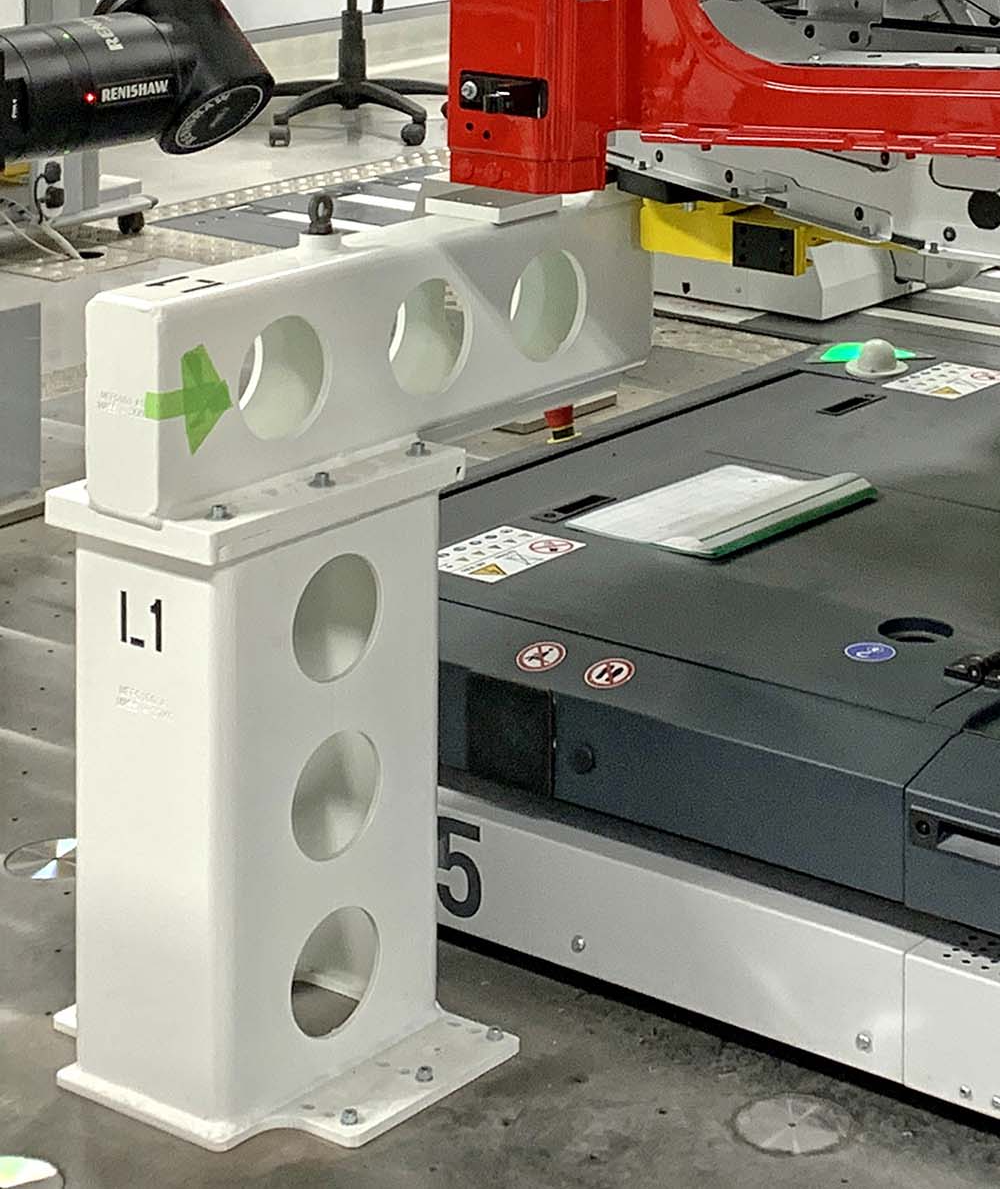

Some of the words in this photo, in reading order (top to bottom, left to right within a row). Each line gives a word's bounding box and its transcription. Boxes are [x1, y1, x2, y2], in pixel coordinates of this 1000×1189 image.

[101, 79, 169, 103] RENISHAW
[120, 590, 162, 653] L1
[437, 816, 482, 918] 5
